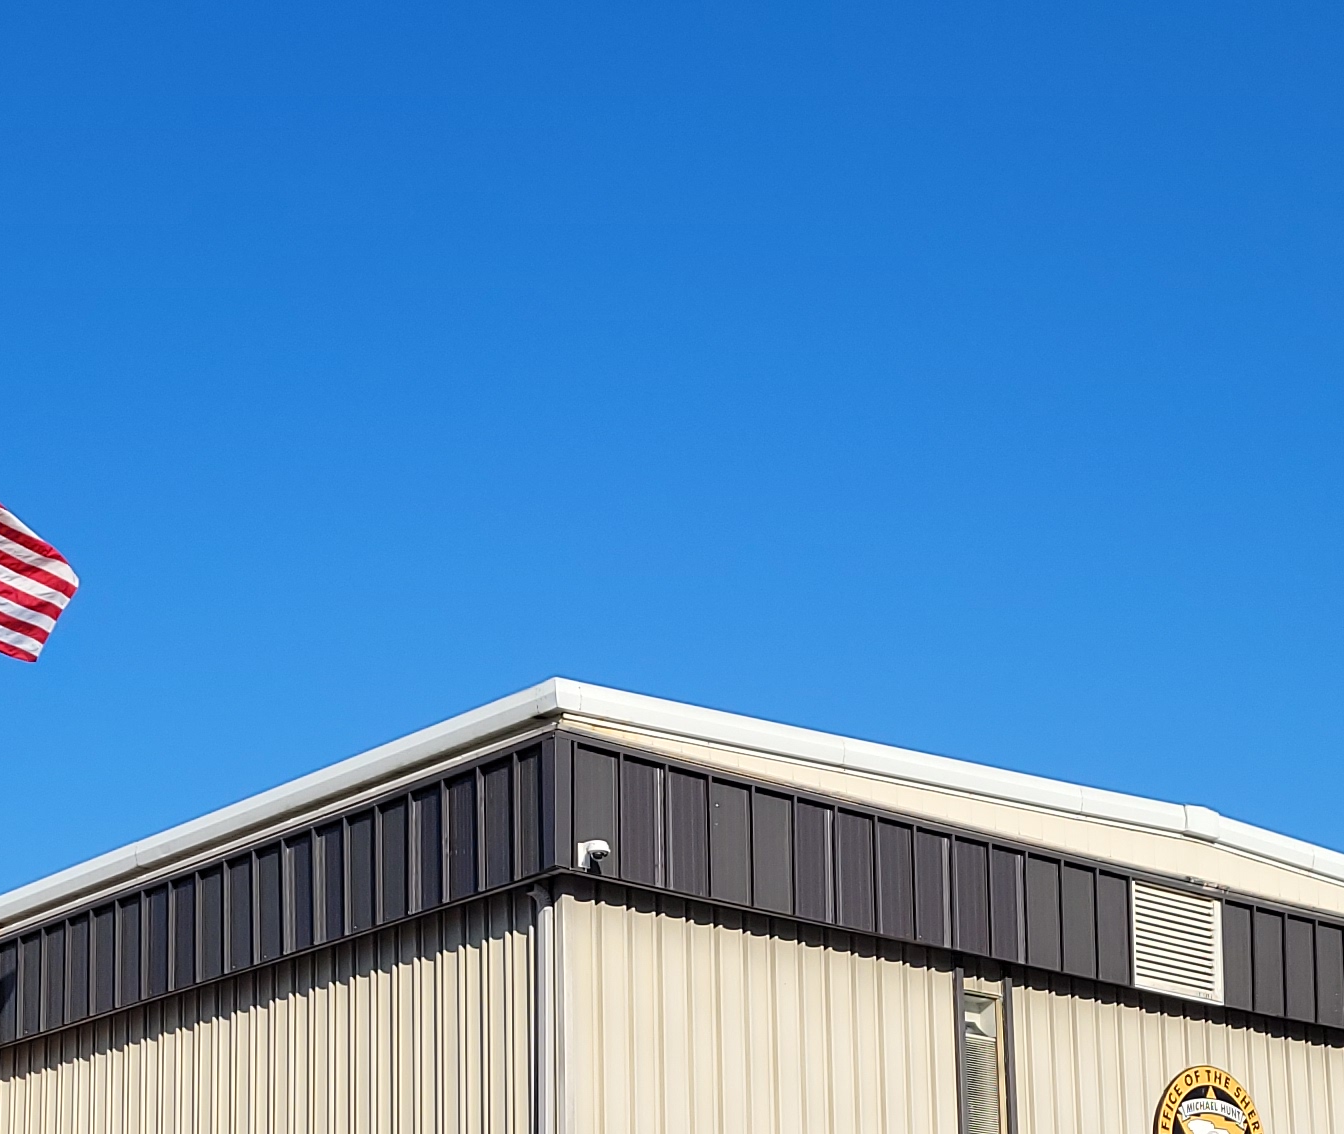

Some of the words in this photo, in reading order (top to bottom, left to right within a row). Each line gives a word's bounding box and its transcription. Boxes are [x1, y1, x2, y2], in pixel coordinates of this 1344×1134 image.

[1184, 1070, 1200, 1086] OF
[1205, 1070, 1231, 1089] THE
[1187, 1101, 1218, 1113] MICHAEL
[1221, 1103, 1241, 1120] HUNT
